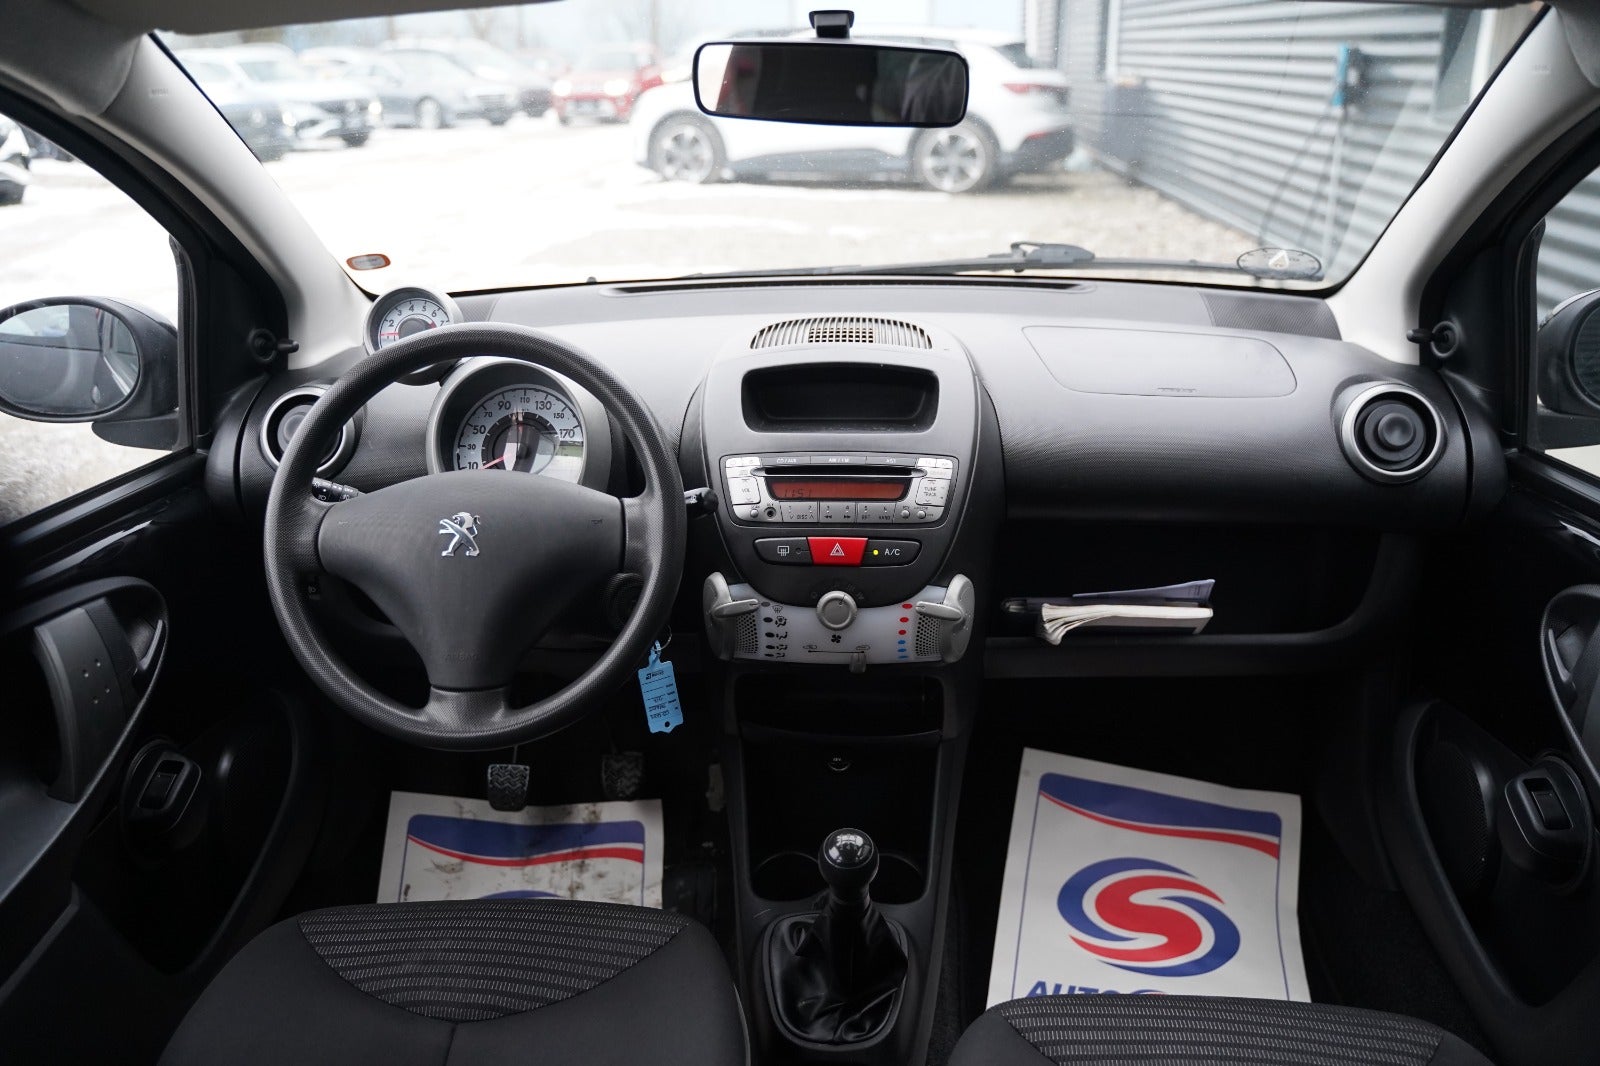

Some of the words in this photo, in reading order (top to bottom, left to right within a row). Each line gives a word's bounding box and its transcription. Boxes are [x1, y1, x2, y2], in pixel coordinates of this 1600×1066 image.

[408, 304, 414, 312] 4
[432, 310, 437, 318] 6
[388, 320, 394, 328] 2
[498, 401, 512, 410] 90
[535, 401, 552, 410] 130
[472, 425, 486, 434] 50
[559, 428, 575, 438] 170
[468, 462, 478, 470] 10
[1025, 980, 1120, 998] AUT
